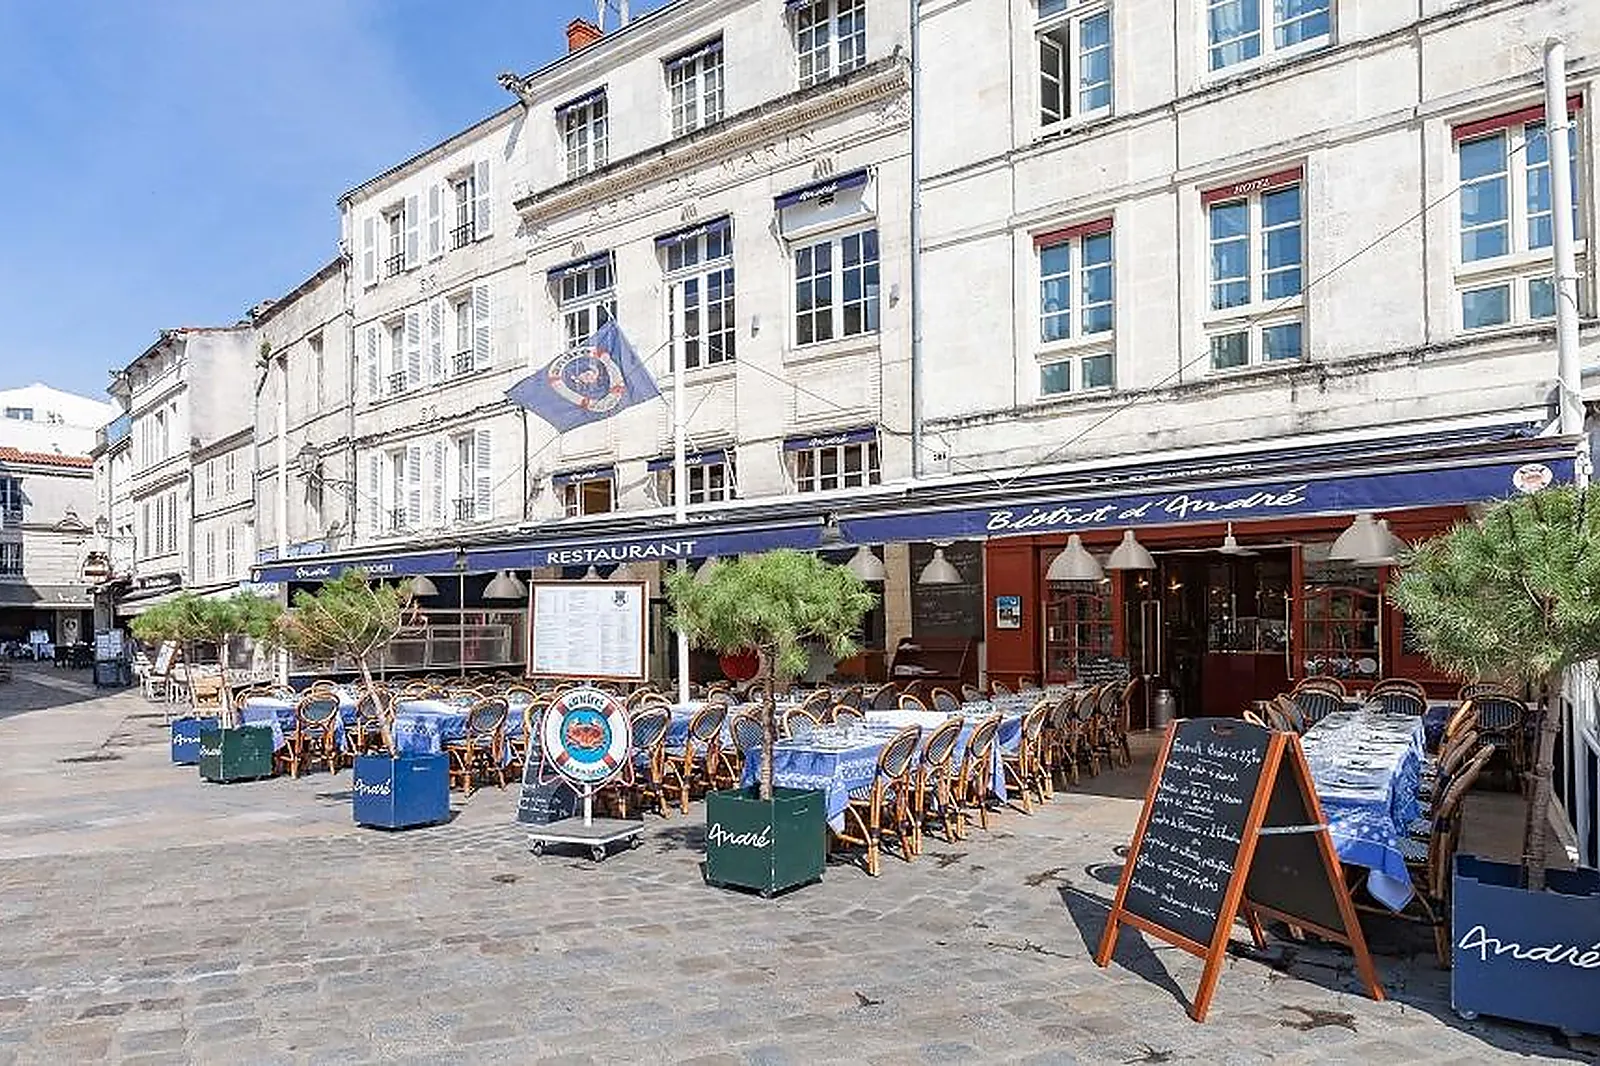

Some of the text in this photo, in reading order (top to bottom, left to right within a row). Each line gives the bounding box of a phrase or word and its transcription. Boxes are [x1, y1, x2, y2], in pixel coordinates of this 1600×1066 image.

[719, 128, 818, 173] MARIN
[987, 504, 1118, 530] Bistrot
[547, 541, 697, 564] RESTAURANT
[354, 778, 391, 797] André
[708, 822, 771, 848] André
[1458, 925, 1600, 969] André
